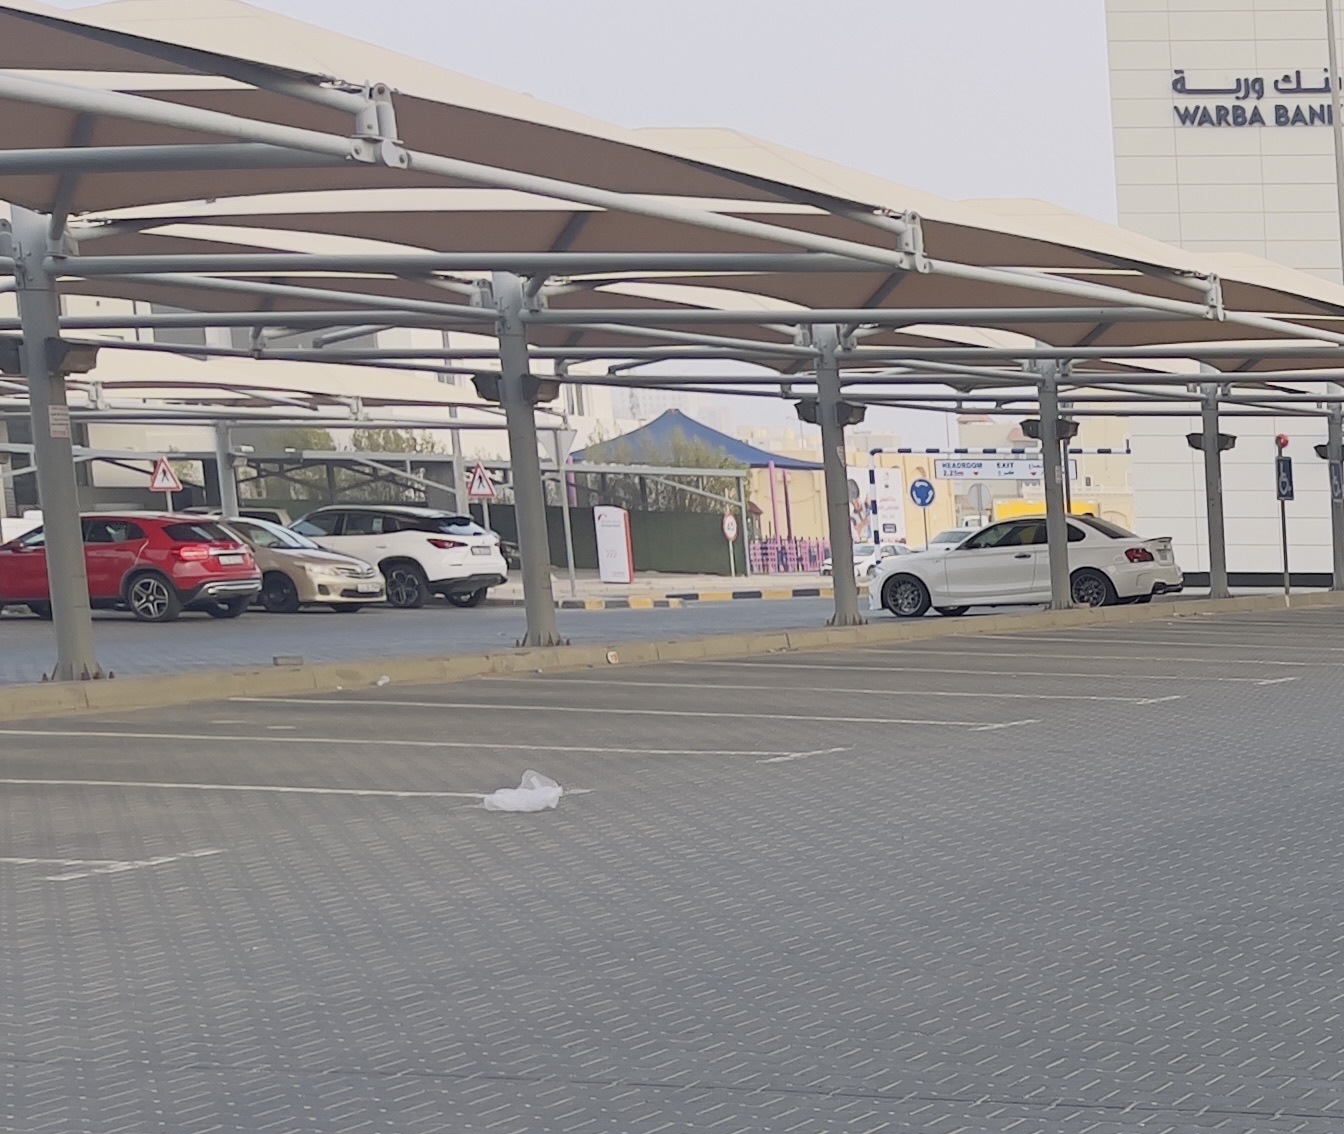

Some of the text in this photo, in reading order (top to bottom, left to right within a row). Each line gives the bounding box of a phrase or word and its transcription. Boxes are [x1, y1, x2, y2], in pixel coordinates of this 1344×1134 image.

[1172, 68, 1342, 100] نك وربة
[1173, 104, 1266, 127] WARBA
